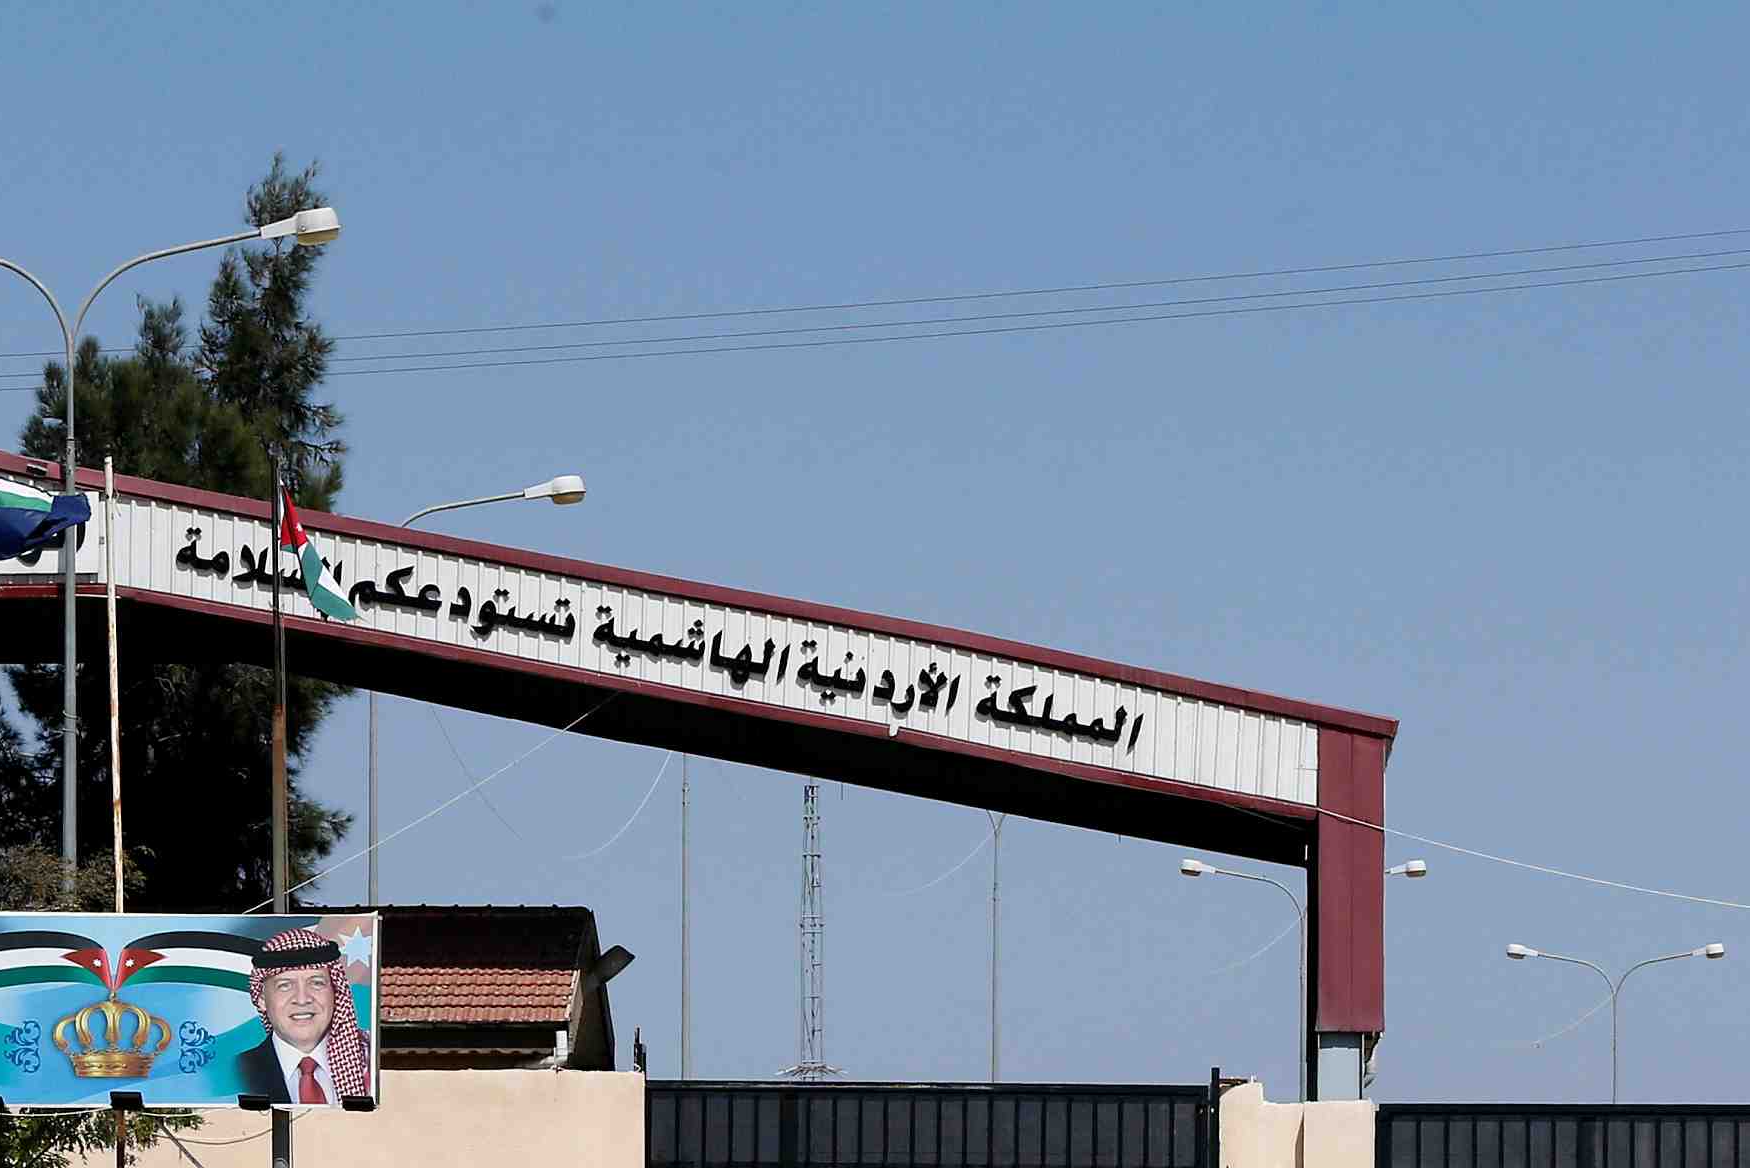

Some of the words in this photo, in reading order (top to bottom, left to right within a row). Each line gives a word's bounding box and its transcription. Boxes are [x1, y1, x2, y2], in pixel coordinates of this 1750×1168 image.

[175, 527, 343, 592] اسلامة
[348, 566, 576, 641] تستودعكم
[593, 605, 791, 687] الهاشمية
[797, 639, 961, 715] الأردنية
[976, 675, 1144, 752] المملكة
